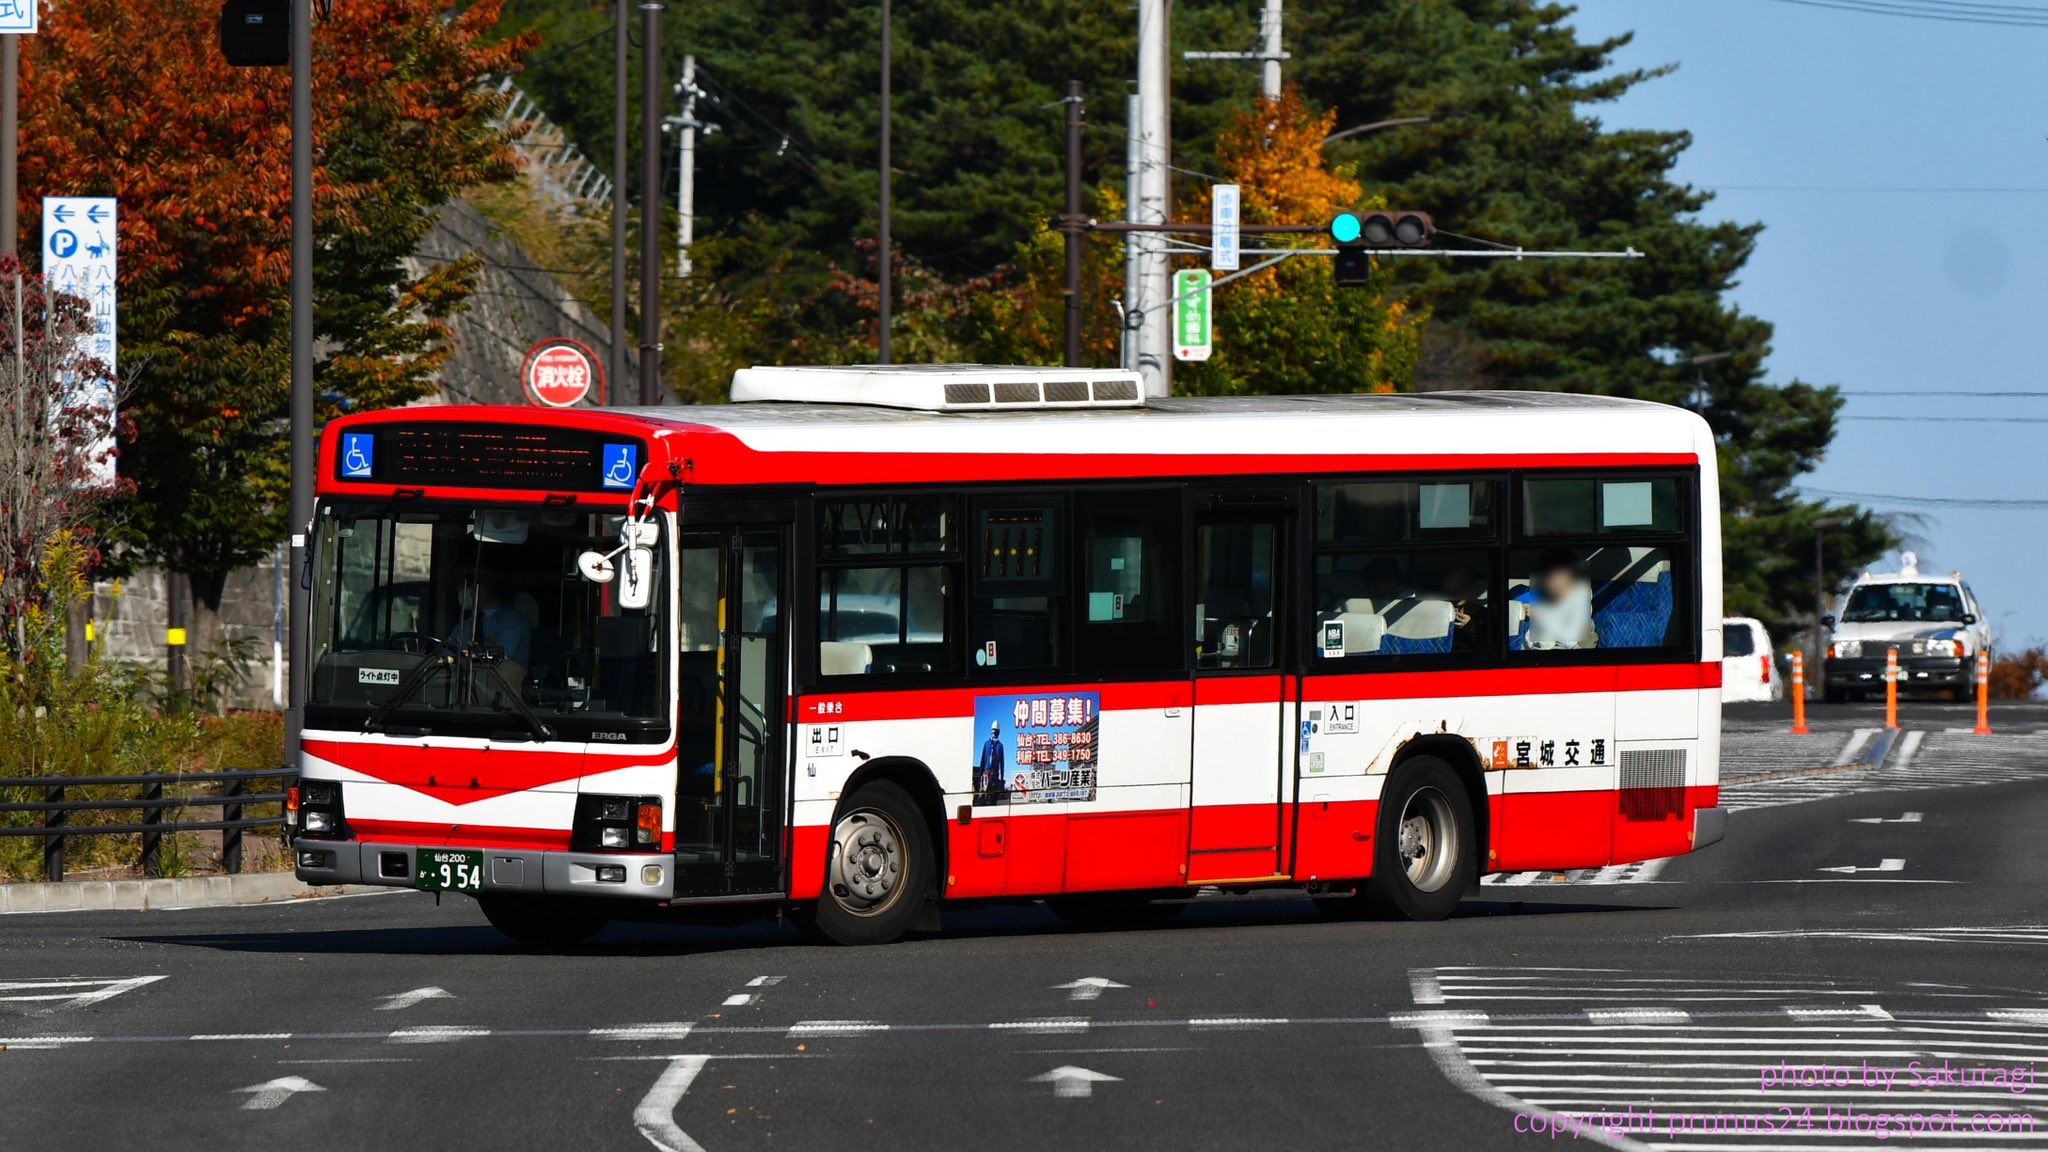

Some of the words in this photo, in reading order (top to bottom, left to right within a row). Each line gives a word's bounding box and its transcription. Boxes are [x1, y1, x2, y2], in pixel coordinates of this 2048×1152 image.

[537, 365, 585, 388] 消火栓
[360, 670, 398, 682] ライト点灯中
[809, 702, 842, 714] 一般乗合
[1330, 705, 1354, 721] 入口
[1330, 723, 1354, 731] ENTRANCE
[591, 731, 627, 740] ERGA
[812, 727, 838, 744] 出口
[1053, 731, 1091, 745] 386-8630
[815, 745, 834, 754] EXIT
[1052, 748, 1091, 762] 349-1750
[1516, 738, 1605, 767] 宮城交通
